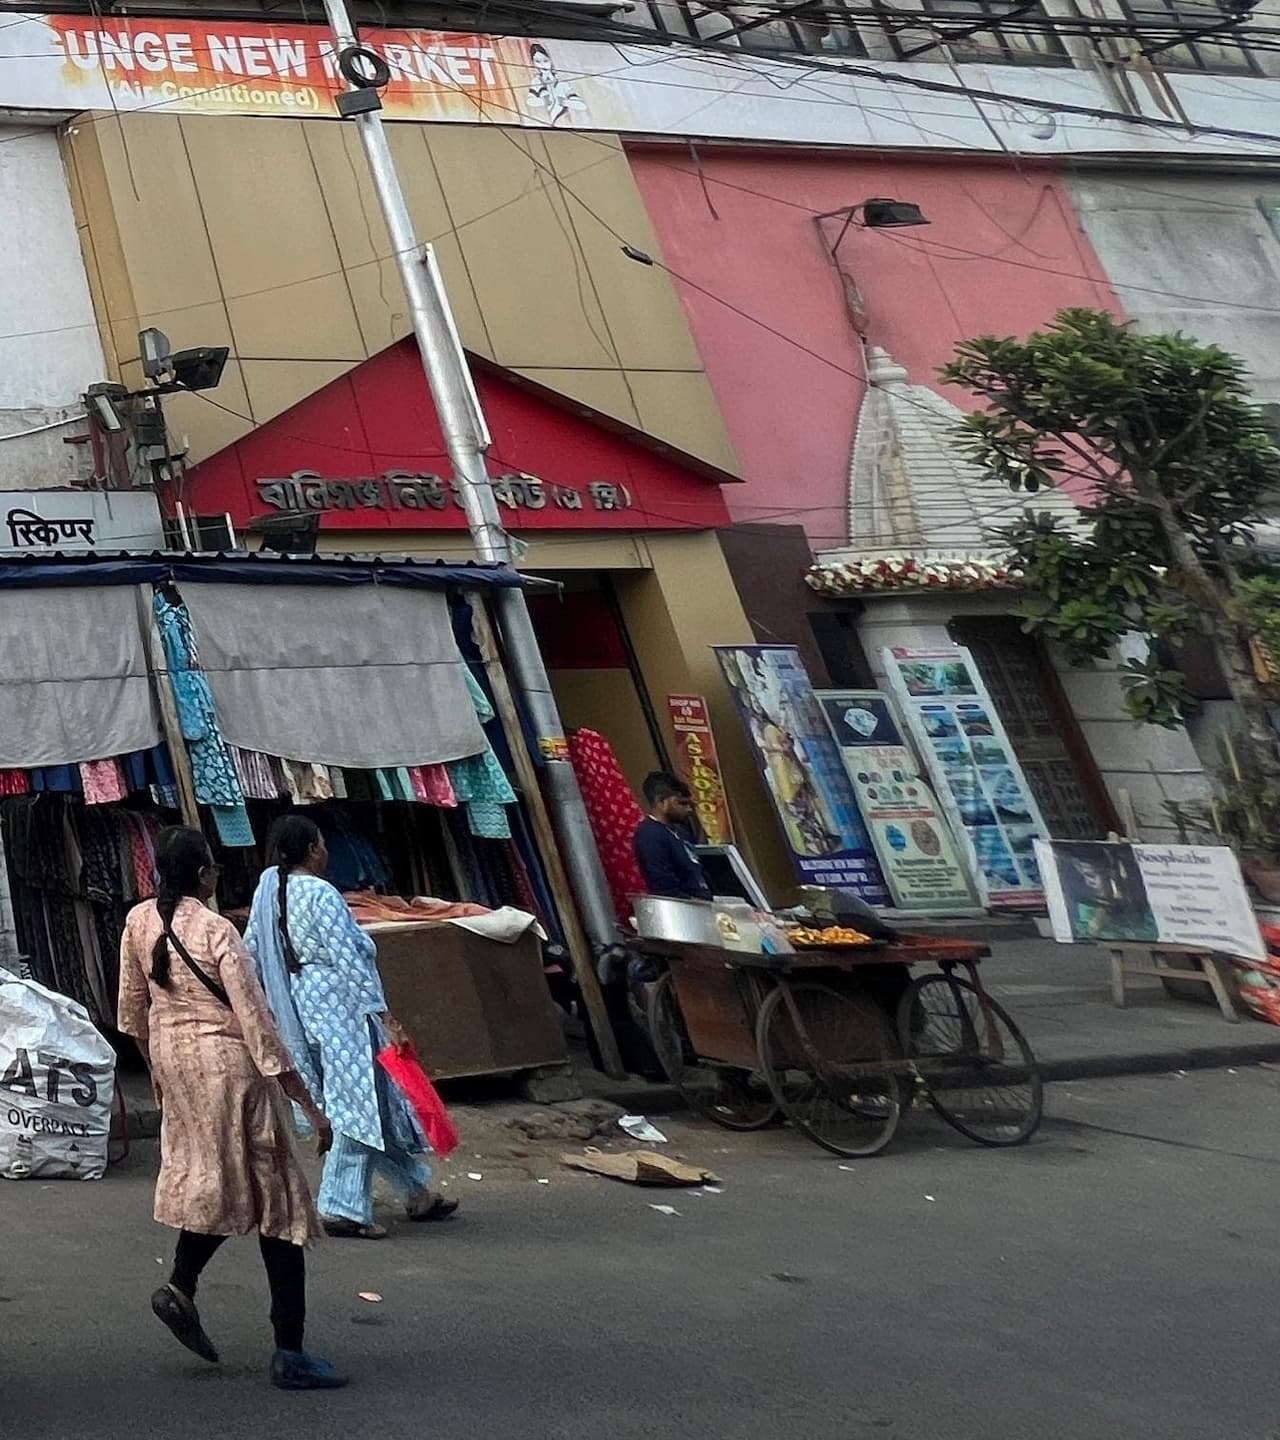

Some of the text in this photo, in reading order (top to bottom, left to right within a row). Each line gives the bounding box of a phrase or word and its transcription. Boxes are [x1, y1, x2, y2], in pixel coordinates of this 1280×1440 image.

[205, 34, 308, 78] NEW
[160, 81, 320, 110] Conditioned)
[6, 509, 95, 547] स्किपर
[7, 1109, 91, 1138] OVERPACK
